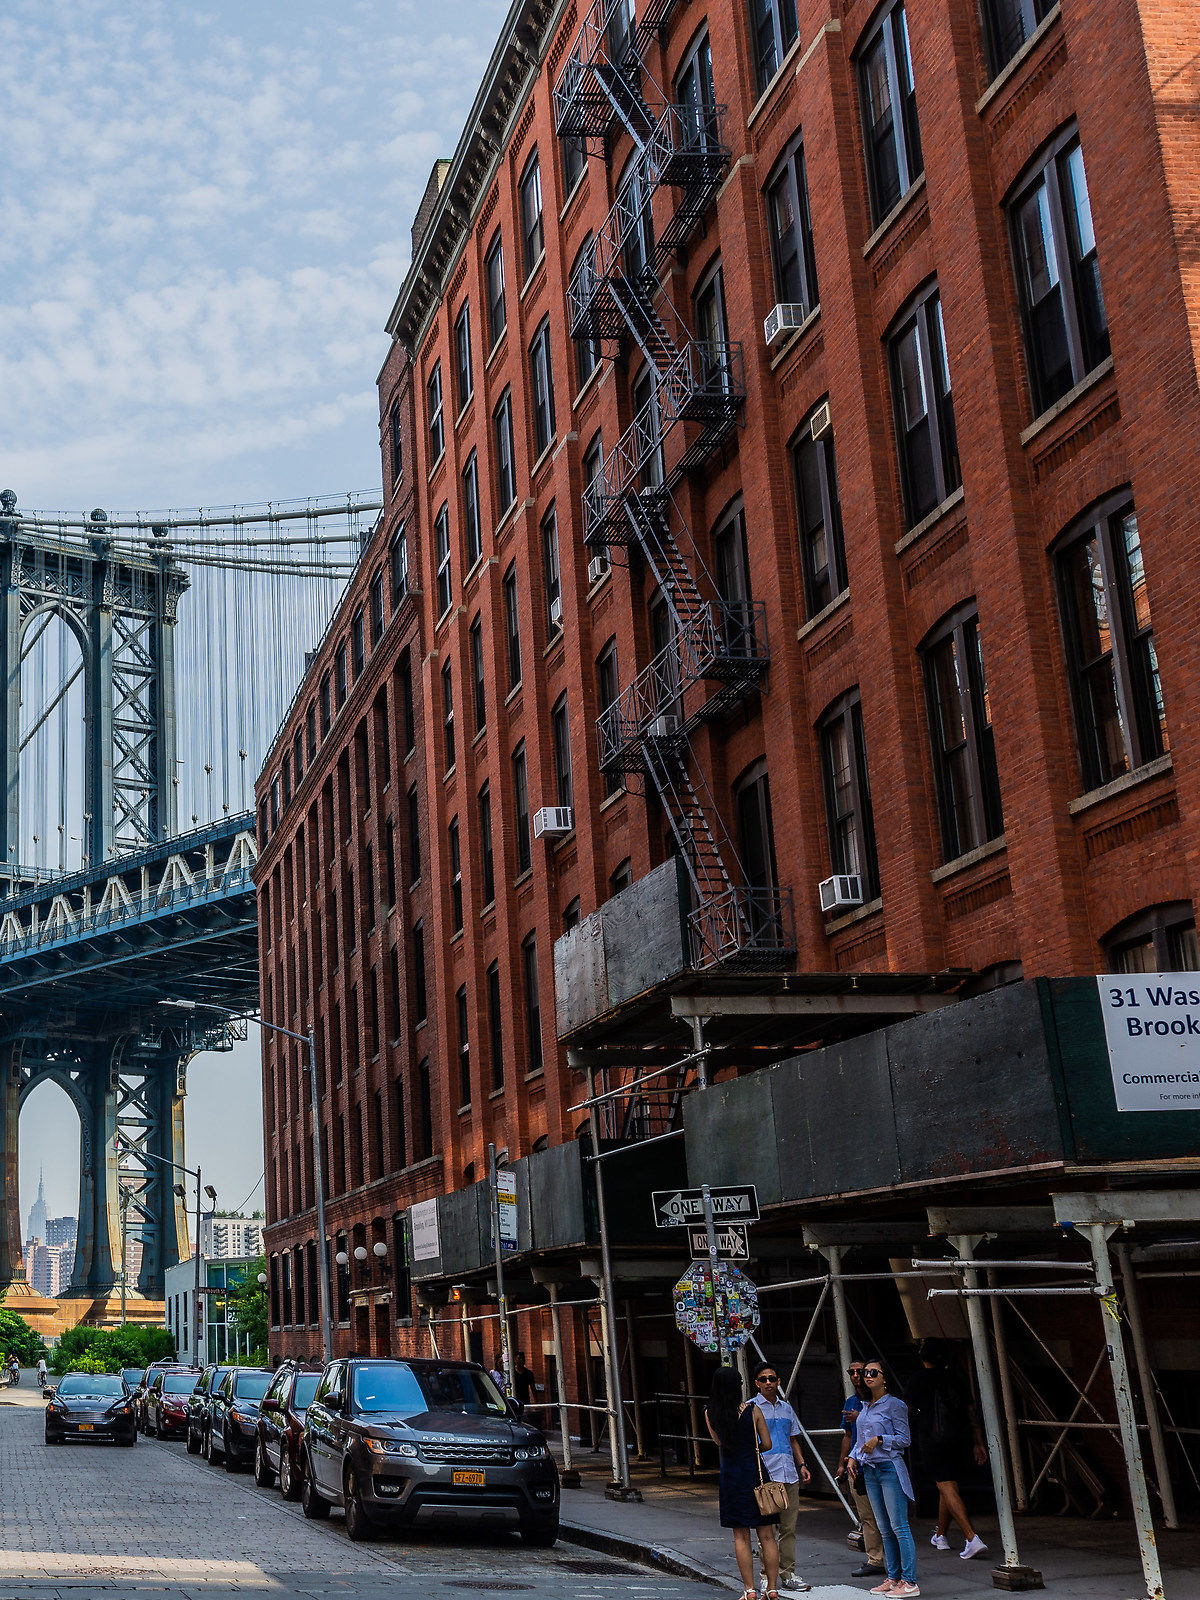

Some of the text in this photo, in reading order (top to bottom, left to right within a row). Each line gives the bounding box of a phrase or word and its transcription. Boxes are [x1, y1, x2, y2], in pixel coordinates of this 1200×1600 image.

[1109, 986, 1200, 1008] 31 Was
[1126, 1014, 1200, 1037] Brook
[1123, 1070, 1200, 1085] Commercia
[670, 1197, 743, 1215] ONE WAY
[697, 1235, 737, 1249] ON WAY
